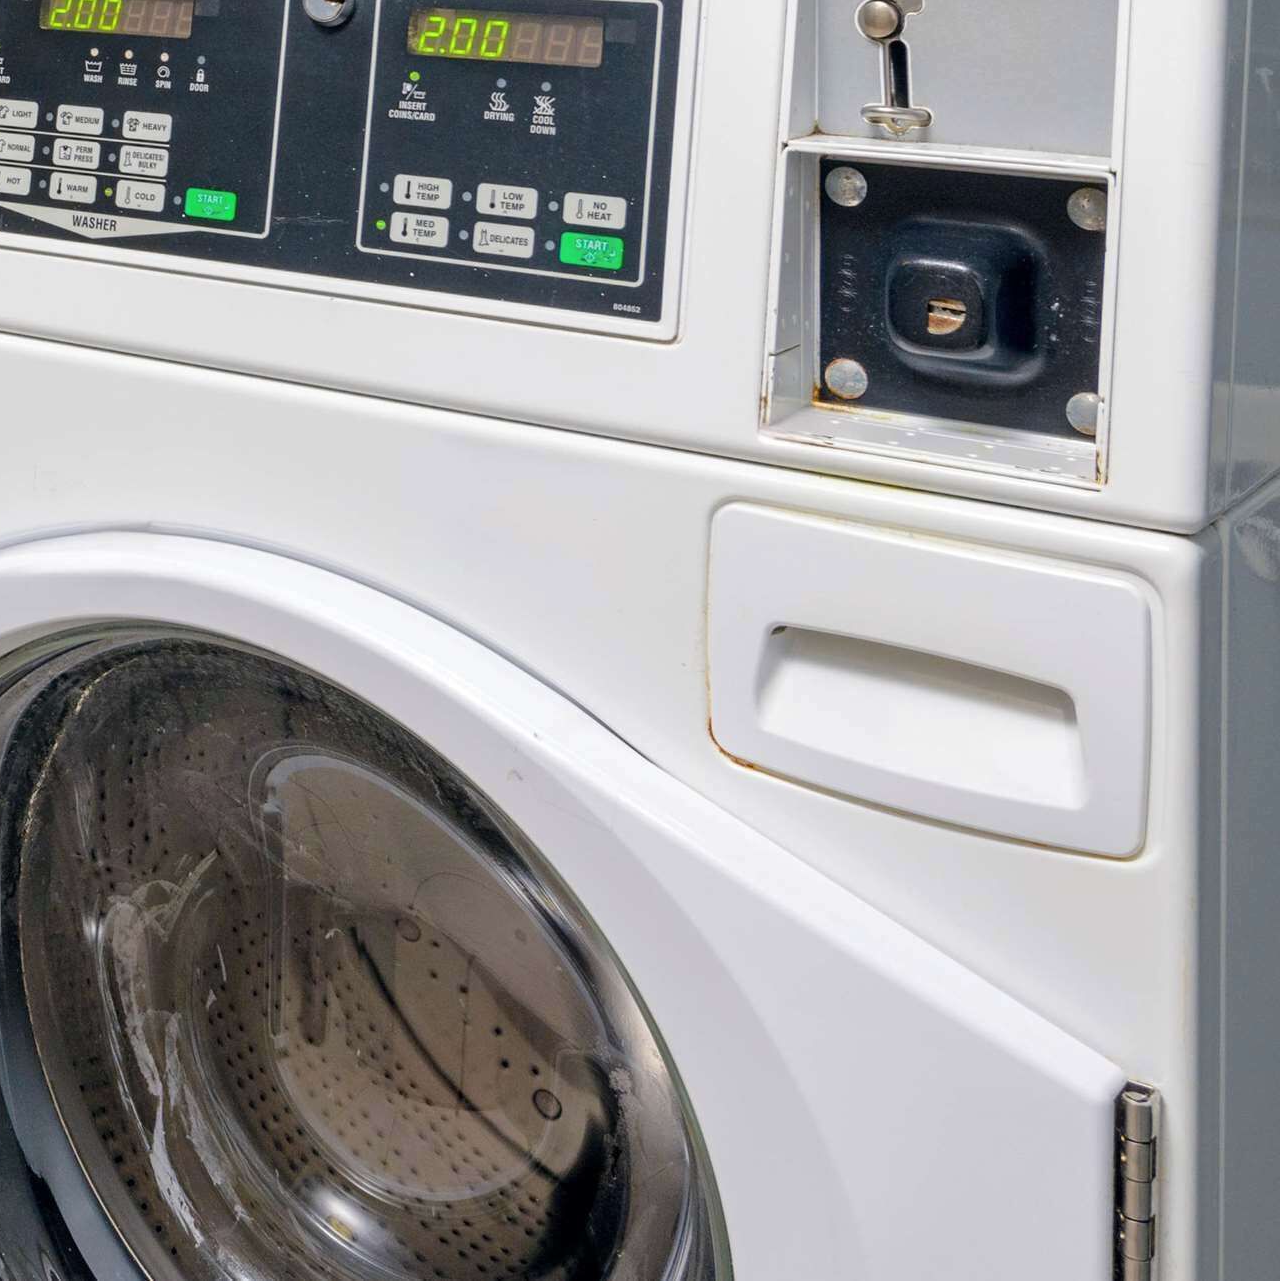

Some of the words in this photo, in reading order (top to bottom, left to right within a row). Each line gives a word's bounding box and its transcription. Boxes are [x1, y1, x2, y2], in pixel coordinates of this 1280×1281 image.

[417, 16, 509, 58] 2.00
[83, 74, 103, 84] WASH
[118, 76, 138, 87] RINSE
[155, 79, 171, 89] SPIN
[189, 82, 209, 92] DOOR
[398, 100, 426, 111] INSERT
[12, 110, 32, 119] LIGHT
[388, 109, 435, 122] COINS/CARD
[484, 110, 515, 122] DRYING
[75, 115, 100, 125] MEDIUM
[532, 115, 555, 126] COOL
[142, 122, 167, 132] HEAVY
[529, 124, 556, 136] DOWN
[7, 143, 31, 153] NORMAL
[75, 145, 93, 154] PERM
[73, 153, 93, 163] PRESS
[138, 160, 157, 169] BULKY
[6, 176, 21, 185] HOT
[66, 183, 88, 193] WARM
[417, 183, 440, 192] HIGH
[135, 192, 156, 201] COLD
[197, 194, 224, 204] START
[415, 192, 440, 202] TEMP
[503, 192, 524, 201] LOW
[500, 201, 525, 211] TEMP
[592, 201, 607, 211] NO
[587, 210, 612, 221] HEAT
[72, 214, 117, 232] WASHER
[415, 219, 435, 228] MED
[412, 228, 437, 239] TEMP
[490, 234, 529, 247] DELICATES
[575, 238, 609, 252] START
